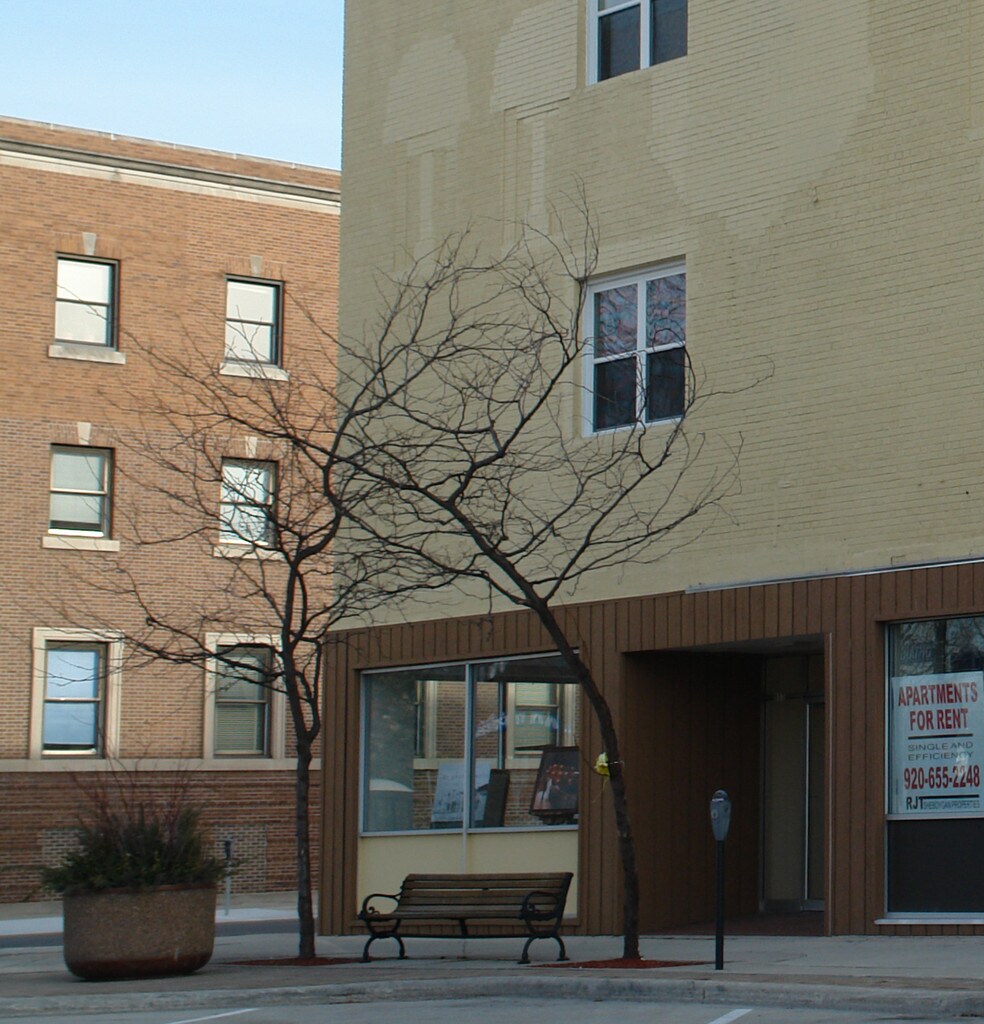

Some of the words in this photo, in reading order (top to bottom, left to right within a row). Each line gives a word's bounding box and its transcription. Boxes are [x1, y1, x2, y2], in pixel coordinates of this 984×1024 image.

[898, 681, 978, 707] APARTMENTS
[909, 710, 934, 731] FOR
[937, 708, 968, 730] RENT
[908, 742, 948, 752] SINGLE
[950, 741, 974, 750] AND
[908, 751, 974, 762] EFFICIENCY
[904, 764, 980, 790] 920-655-2248
[906, 796, 924, 810] RJT
